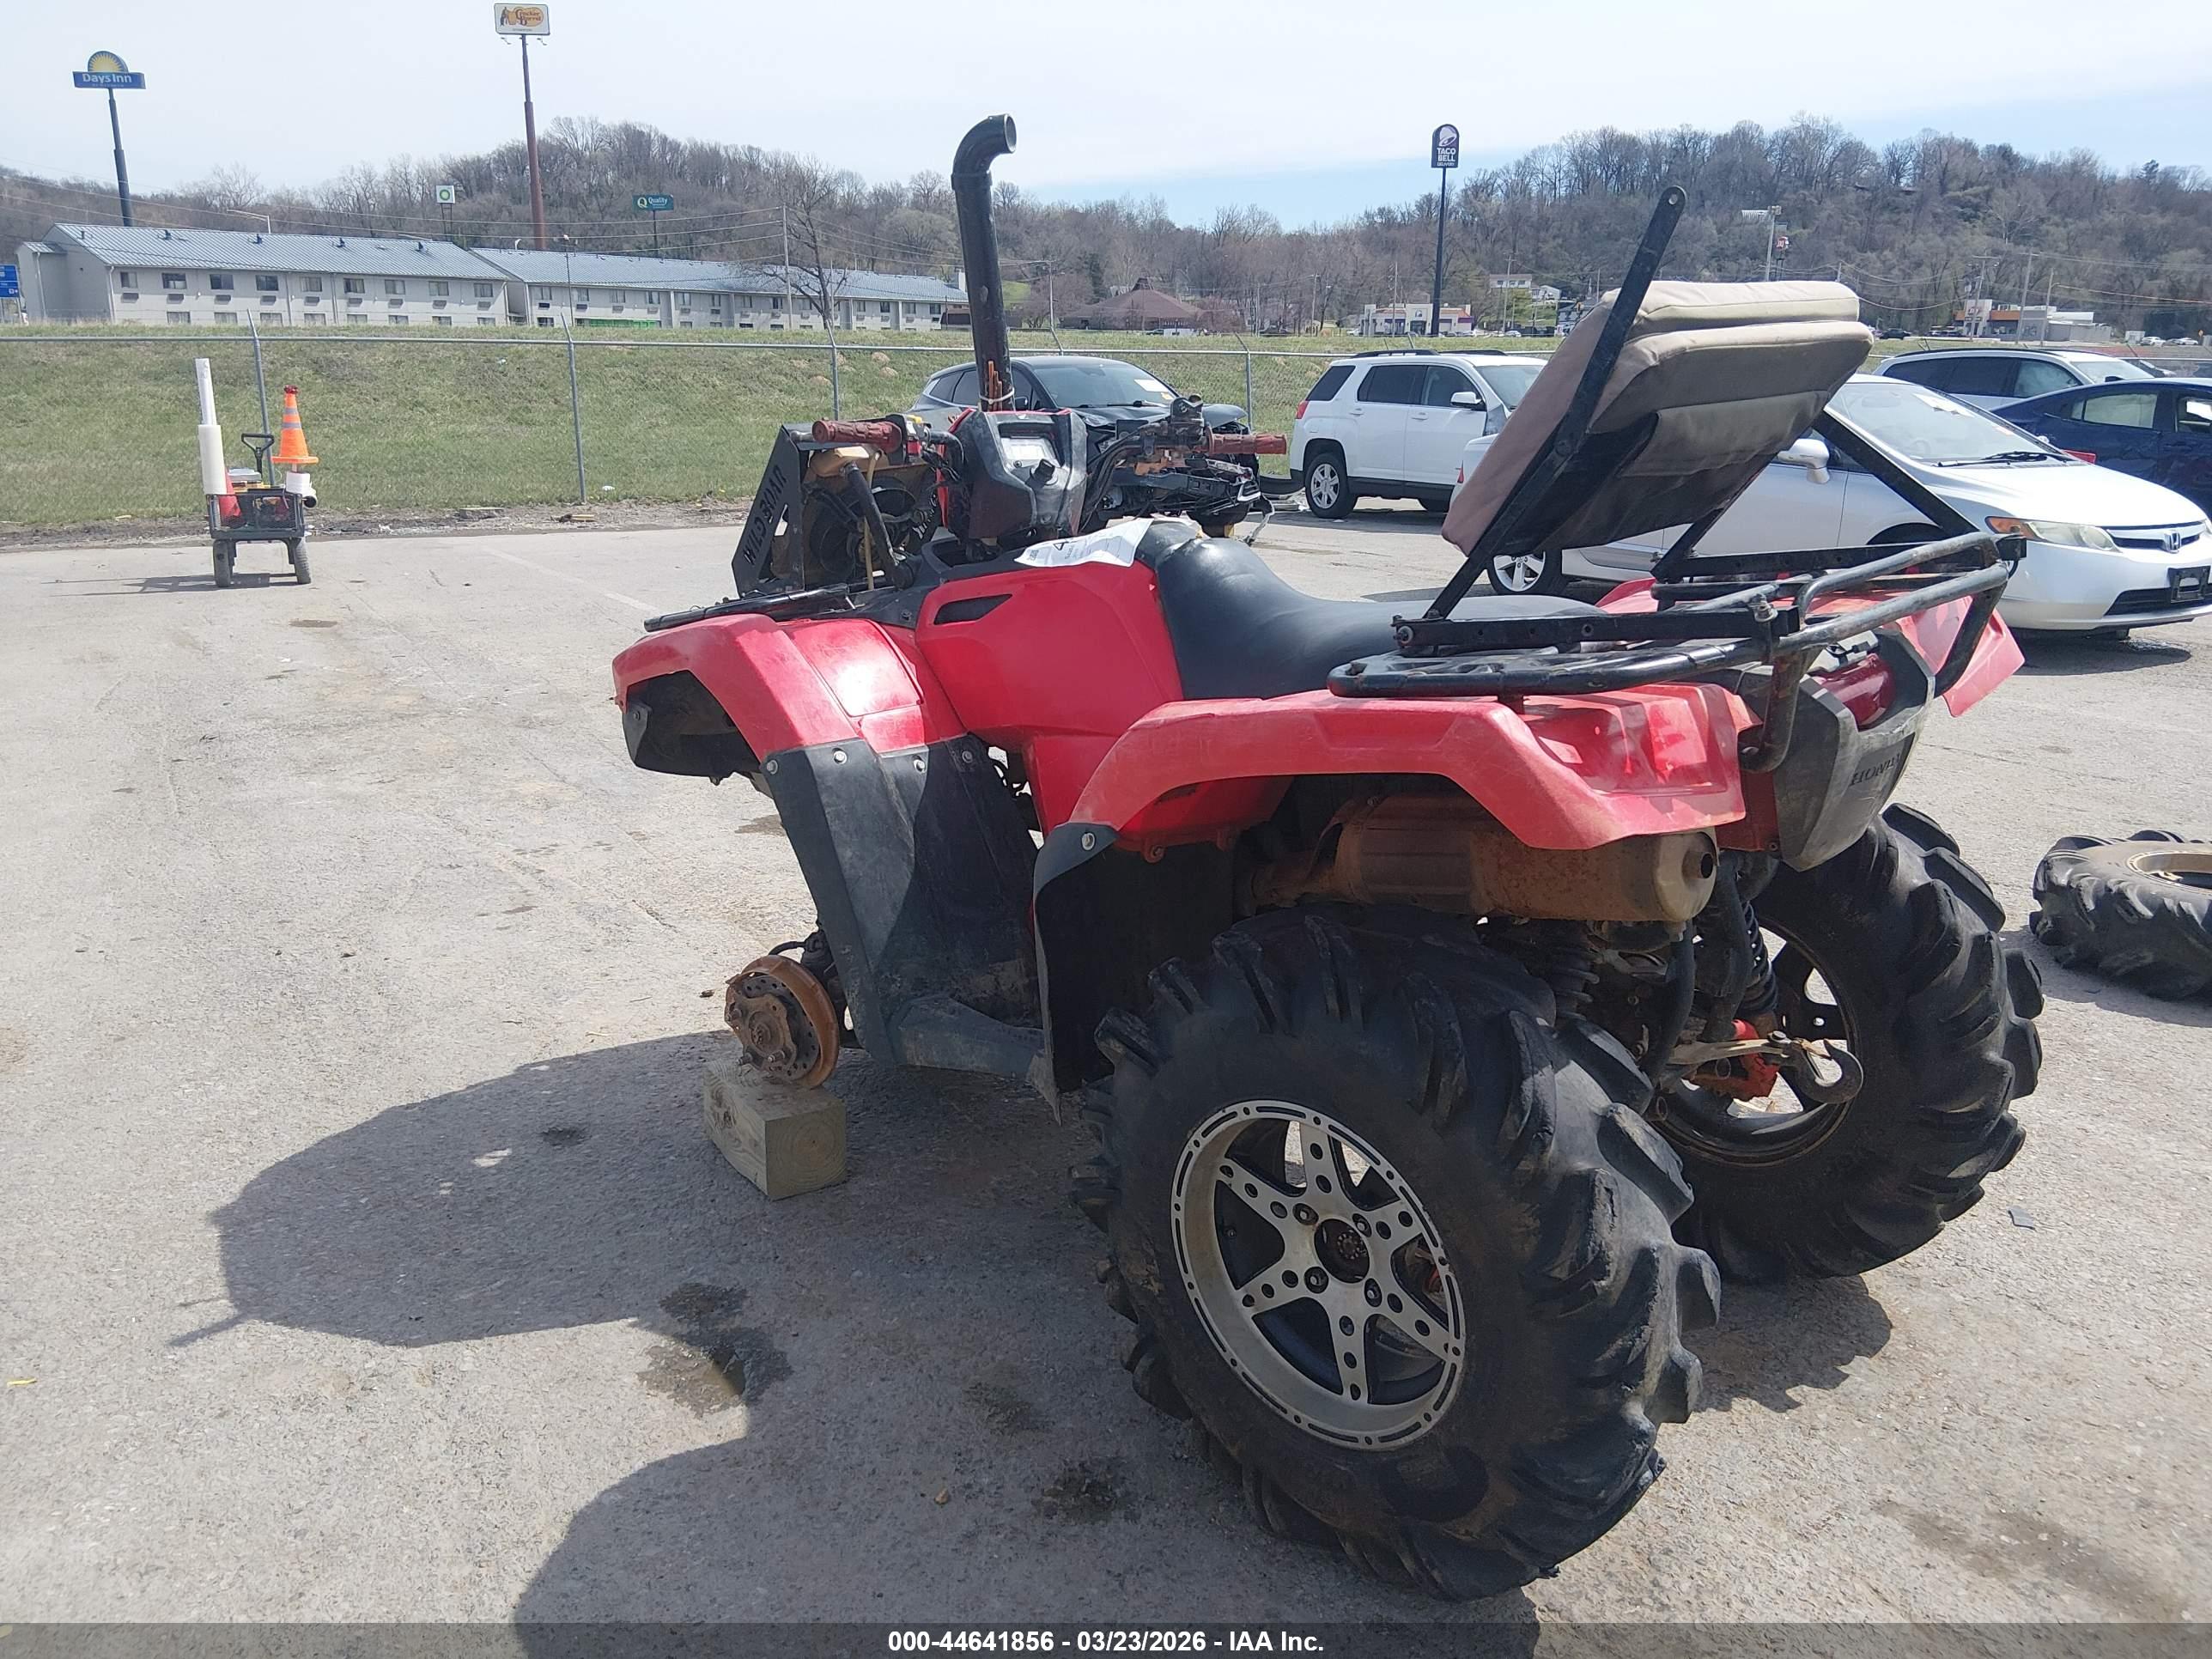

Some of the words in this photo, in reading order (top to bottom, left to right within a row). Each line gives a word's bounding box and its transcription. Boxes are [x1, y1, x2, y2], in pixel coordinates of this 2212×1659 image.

[82, 73, 112, 84] Days
[112, 74, 132, 83] Inn
[1437, 147, 1456, 155] TACO
[648, 196, 668, 206] Quality
[743, 516, 767, 567] WILD
[759, 464, 789, 522] BOAR
